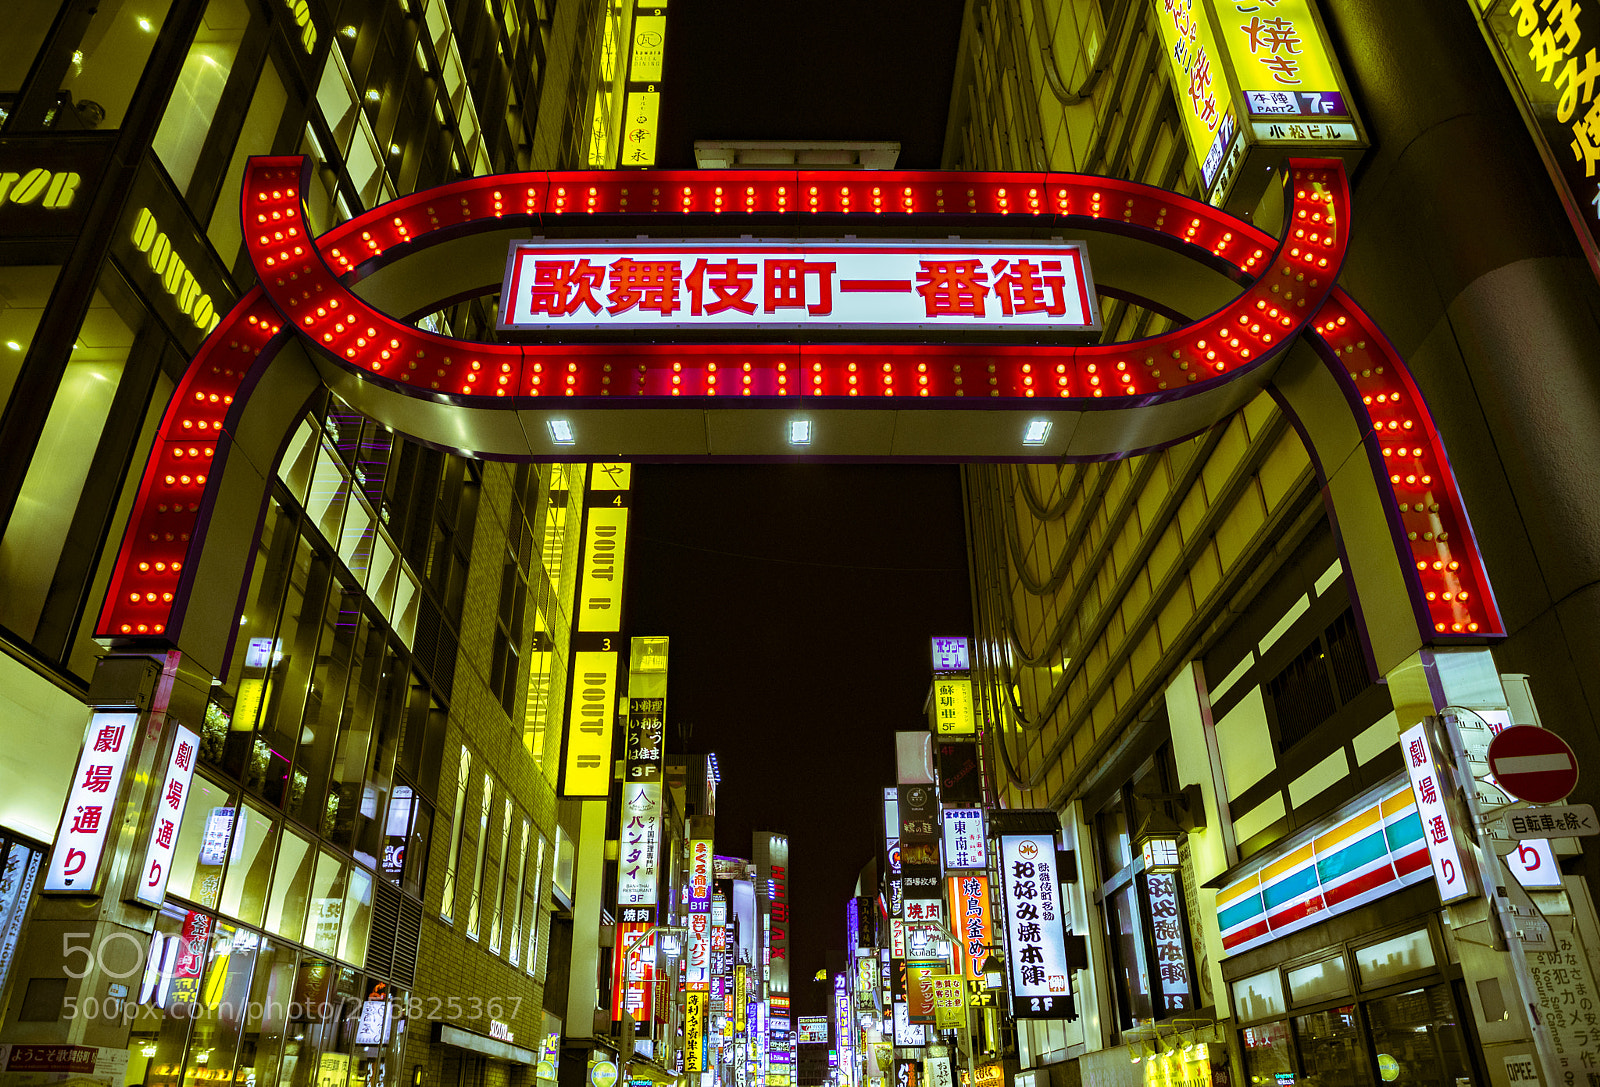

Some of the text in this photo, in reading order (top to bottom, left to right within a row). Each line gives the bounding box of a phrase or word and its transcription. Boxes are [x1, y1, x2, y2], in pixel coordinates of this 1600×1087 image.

[648, 85, 655, 93] 8
[1253, 93, 1289, 105] 本陣
[1301, 93, 1335, 113] 7F
[1269, 124, 1341, 139] 小松ビル
[530, 257, 1067, 318] 歌舞伎町一番街
[613, 495, 622, 506] 4
[602, 638, 611, 651] 3
[631, 700, 662, 712] 小料理
[942, 723, 956, 731] 5F
[631, 767, 656, 776] 3F
[64, 725, 126, 876] 劇場通り
[148, 741, 193, 887] 劇場通り
[1409, 737, 1455, 885] 劇場通り
[1512, 812, 1592, 834] 自転車を除く
[626, 816, 645, 879] バンタイ
[954, 820, 969, 867] 東南荘
[690, 902, 709, 910] B1F
[908, 903, 940, 919] 焼肉
[623, 909, 650, 921] 焼肉
[963, 877, 984, 977] 焼鳥釜めし
[1012, 861, 1047, 987] お好み焼本陣
[934, 980, 960, 988] 悪質な
[935, 990, 960, 998] 客引き
[970, 994, 991, 1006] 2F
[1542, 969, 1554, 993] Your
[1550, 996, 1566, 1029] Safety
[936, 1000, 961, 1008] に注意
[1031, 998, 1053, 1012] 2F
[1531, 967, 1550, 1009] Security
[1546, 1013, 1564, 1054] Camera
[1560, 1056, 1568, 1067] in
